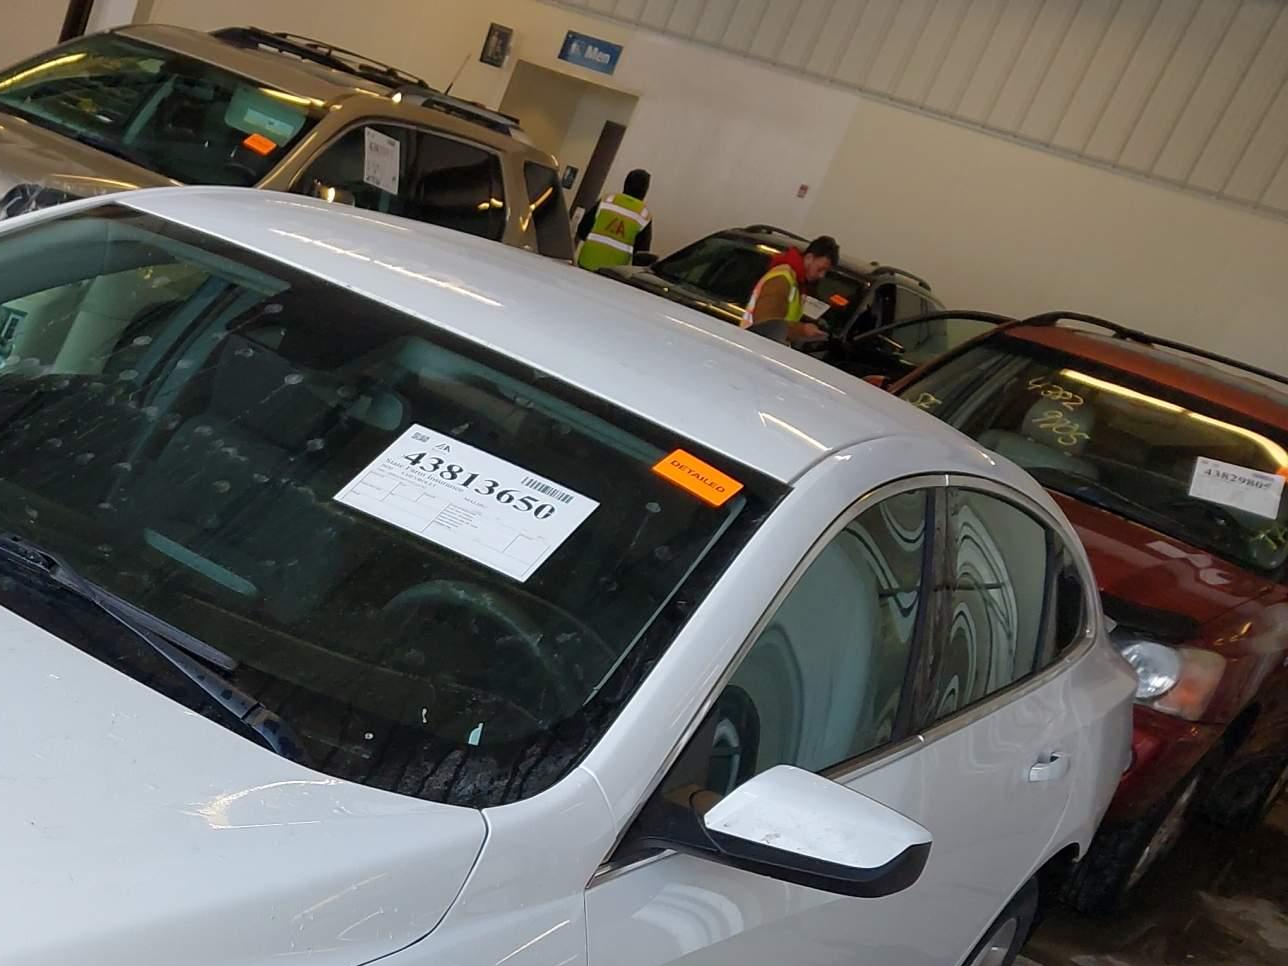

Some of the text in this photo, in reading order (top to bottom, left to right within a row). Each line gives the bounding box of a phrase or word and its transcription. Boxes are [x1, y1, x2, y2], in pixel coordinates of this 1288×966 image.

[584, 45, 610, 64] Men
[404, 452, 556, 520] 43813650
[405, 465, 426, 480] Farm
[427, 475, 465, 492] Insurance
[670, 460, 726, 493] DETAILED
